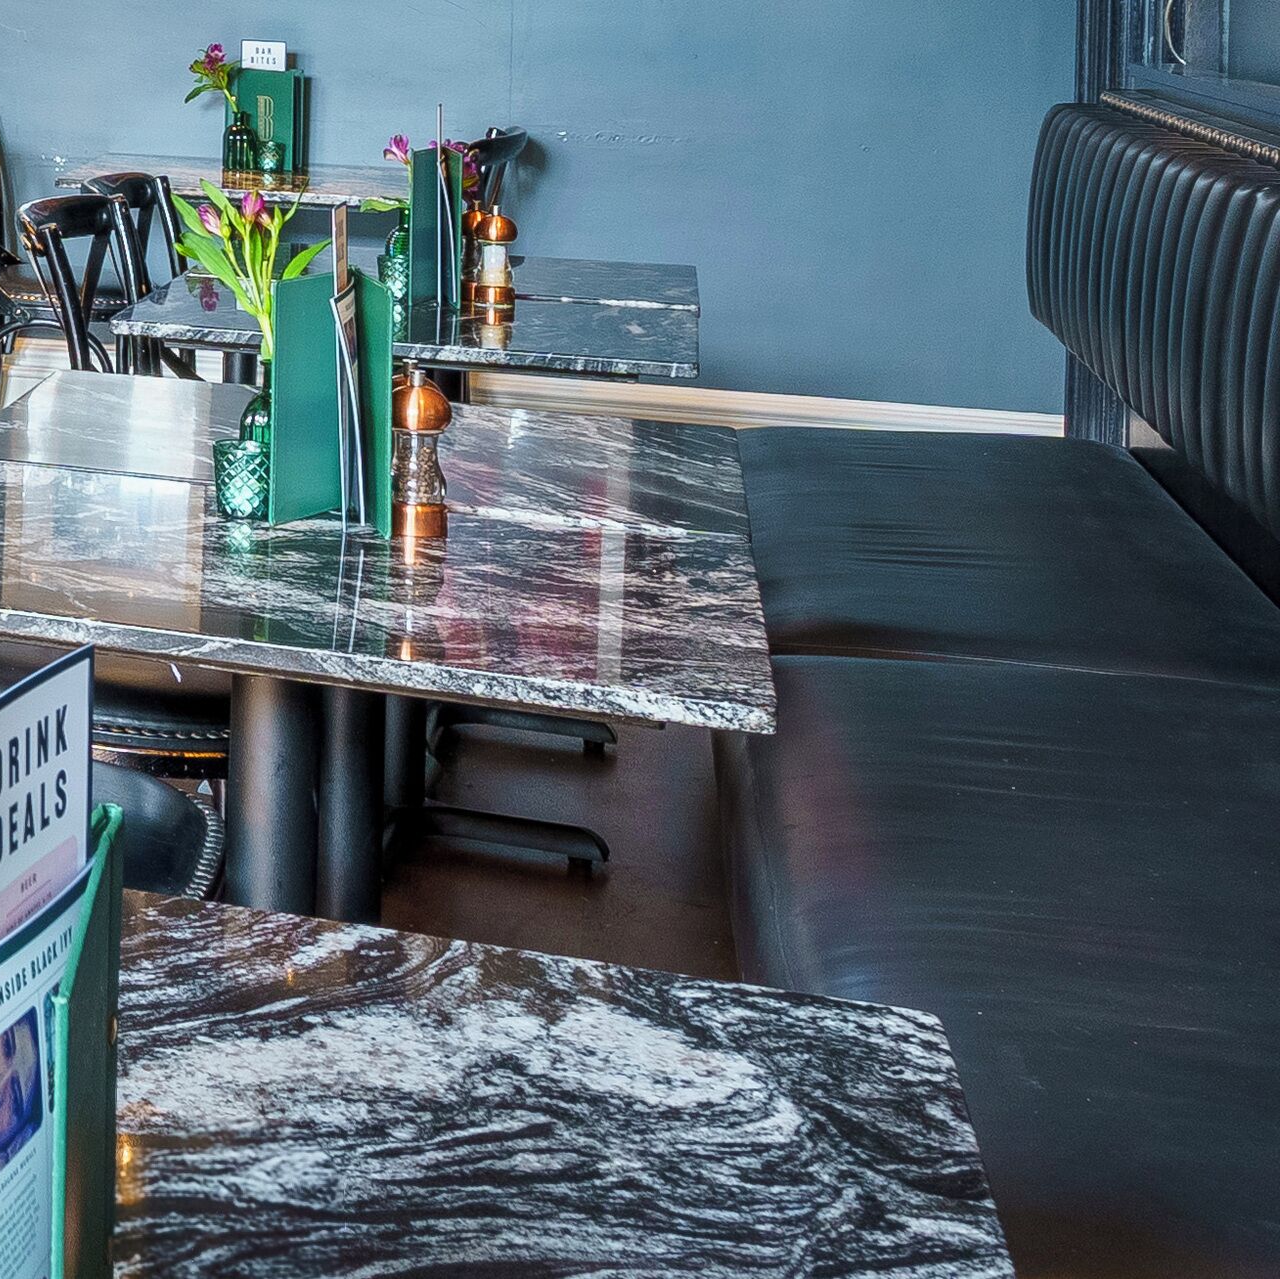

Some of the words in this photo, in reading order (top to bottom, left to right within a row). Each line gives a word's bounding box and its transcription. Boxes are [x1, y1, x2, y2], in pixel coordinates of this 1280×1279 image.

[256, 95, 274, 141] B
[31, 943, 58, 980] BLACK
[59, 925, 73, 953] IVY
